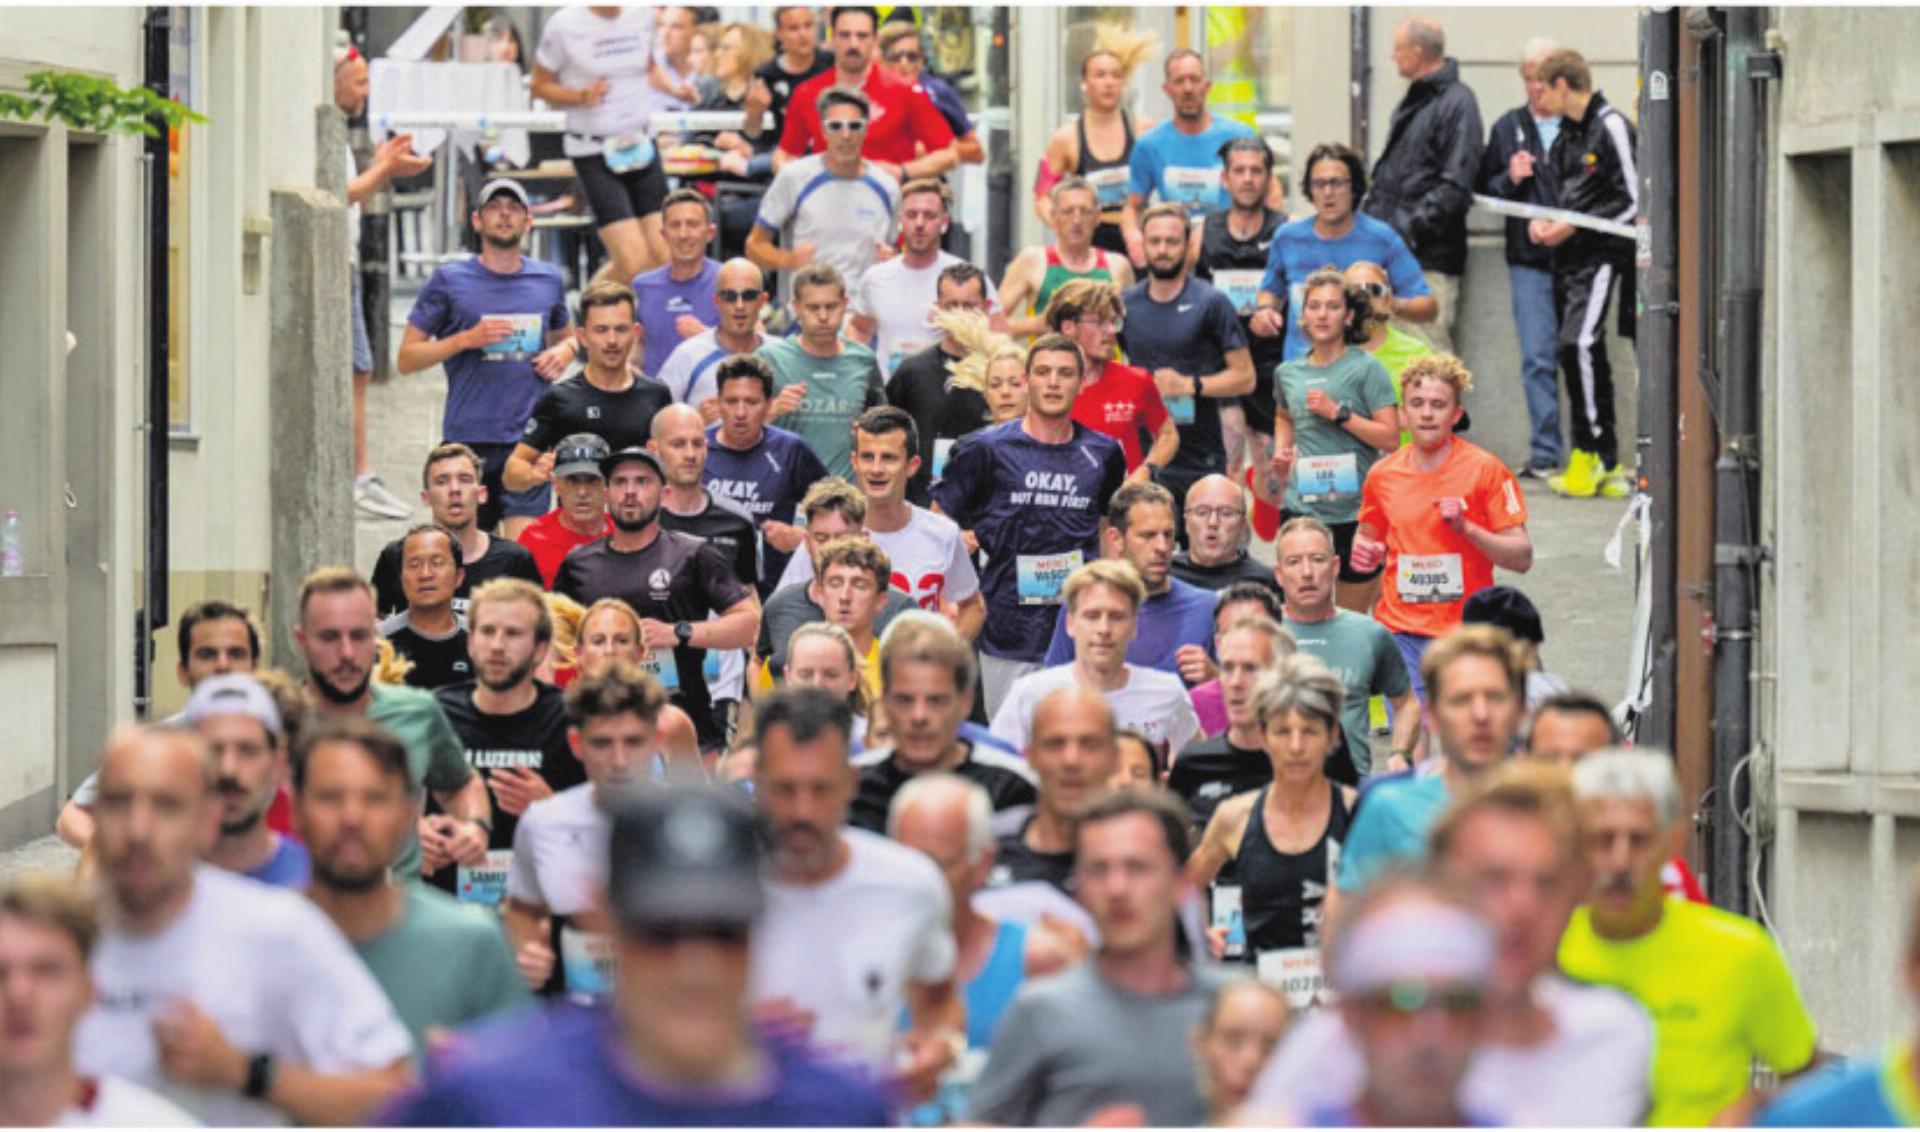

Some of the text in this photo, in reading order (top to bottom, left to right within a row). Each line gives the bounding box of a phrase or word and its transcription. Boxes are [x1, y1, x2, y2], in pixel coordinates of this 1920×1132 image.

[707, 479, 760, 500] OKAY,
[1025, 471, 1078, 494] OKAY,
[1010, 491, 1033, 505] BUT
[1034, 492, 1059, 506] RUN
